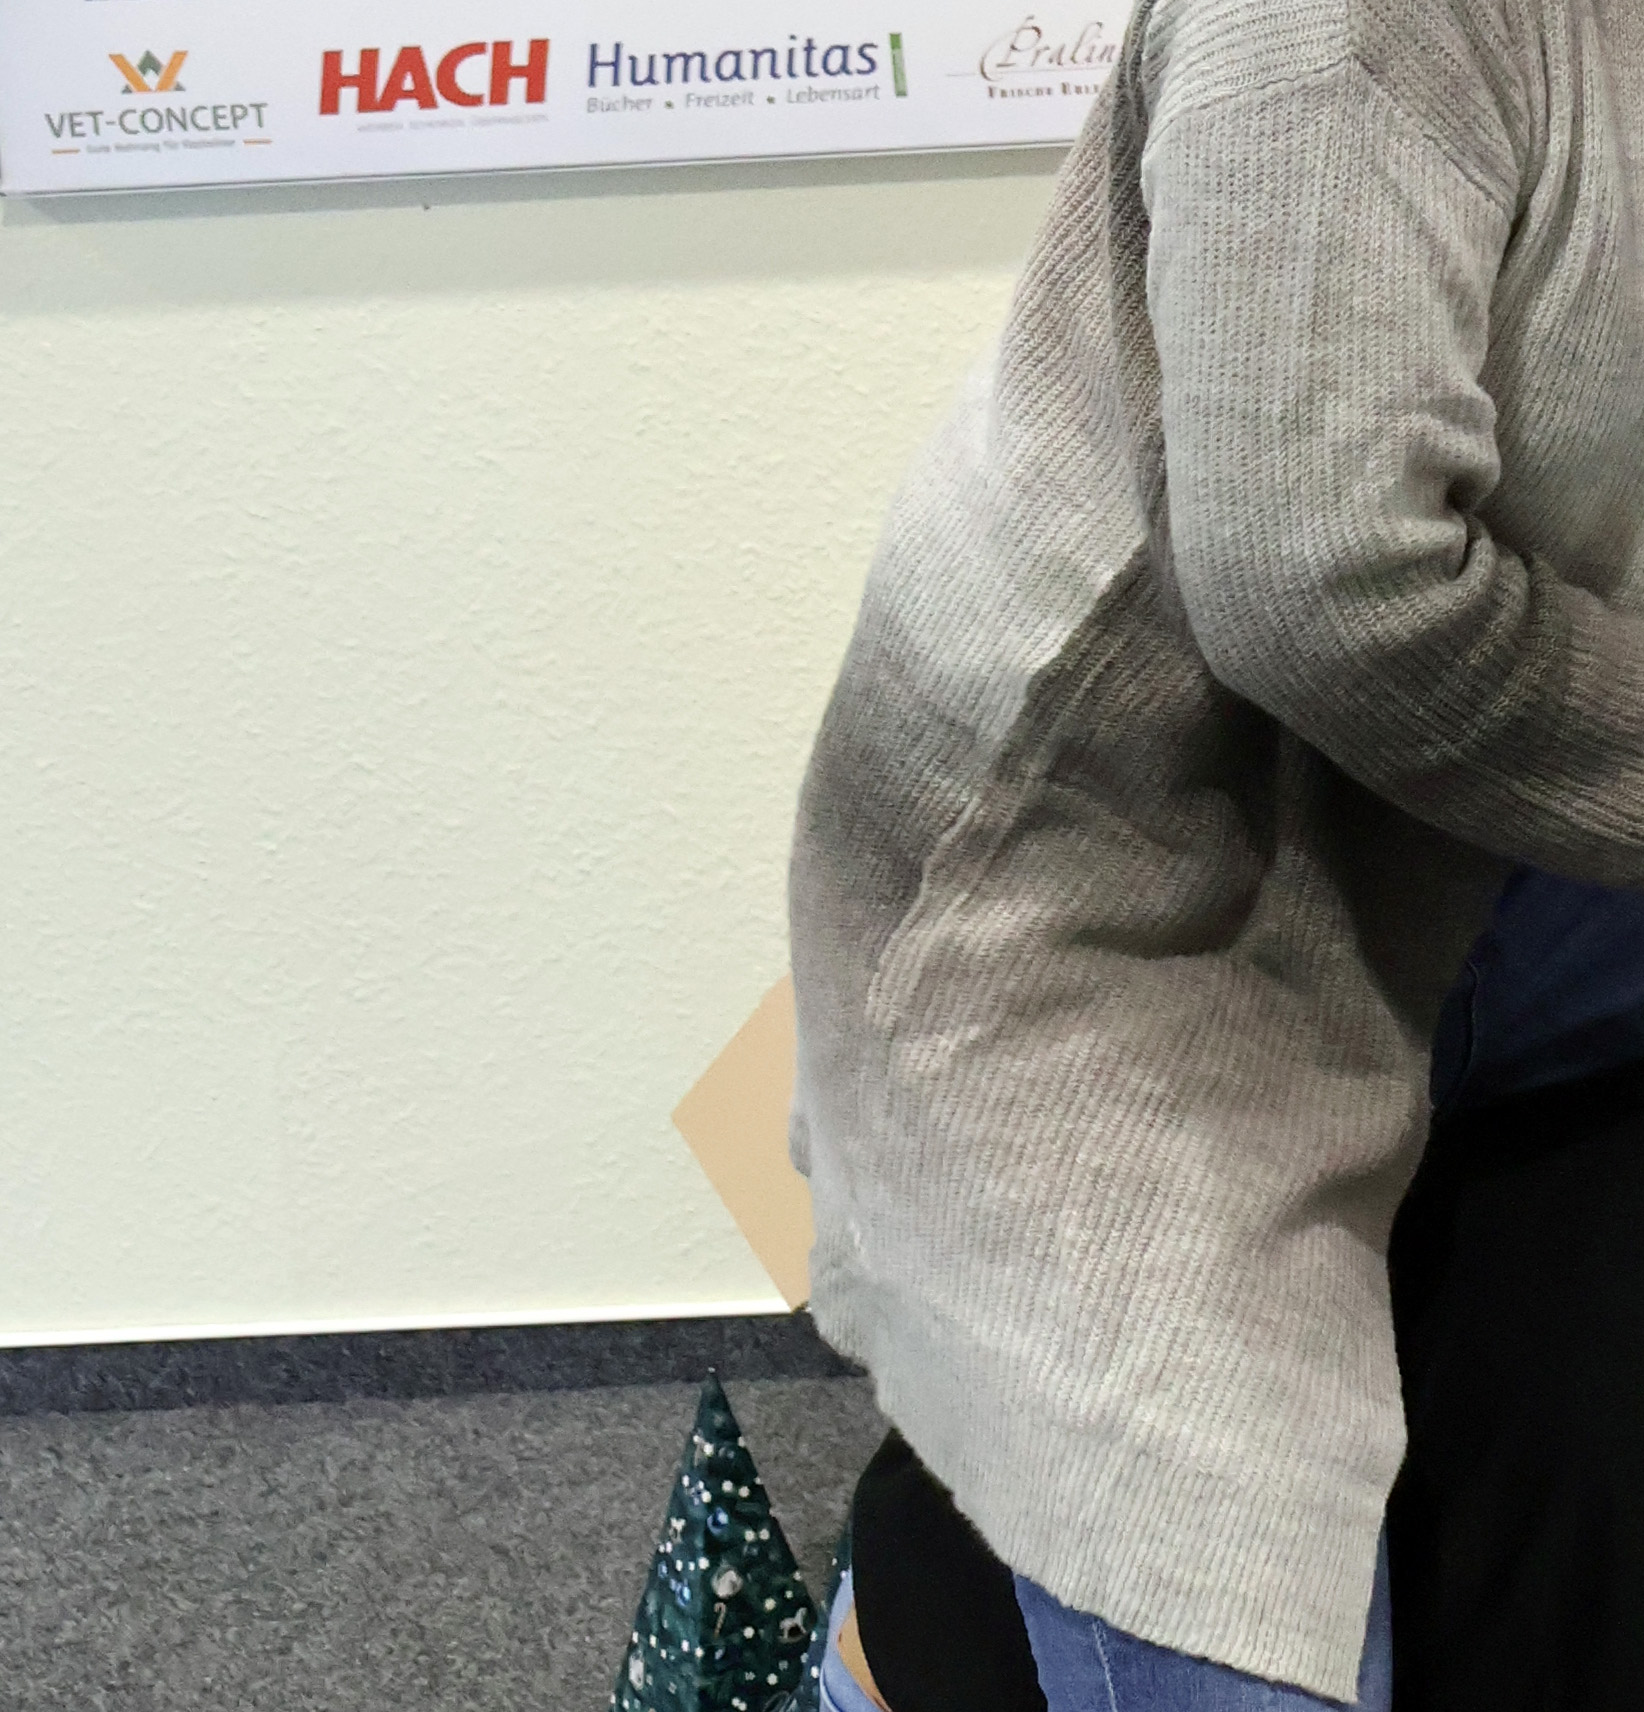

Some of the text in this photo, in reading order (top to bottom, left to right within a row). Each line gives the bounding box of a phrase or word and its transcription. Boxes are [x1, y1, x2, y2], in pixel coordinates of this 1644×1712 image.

[319, 38, 550, 116] HACH
[588, 34, 879, 88] Humanitas
[44, 103, 268, 138] VET-CONCEPT
[586, 84, 880, 114] Bücher Freizeit Lebensart
